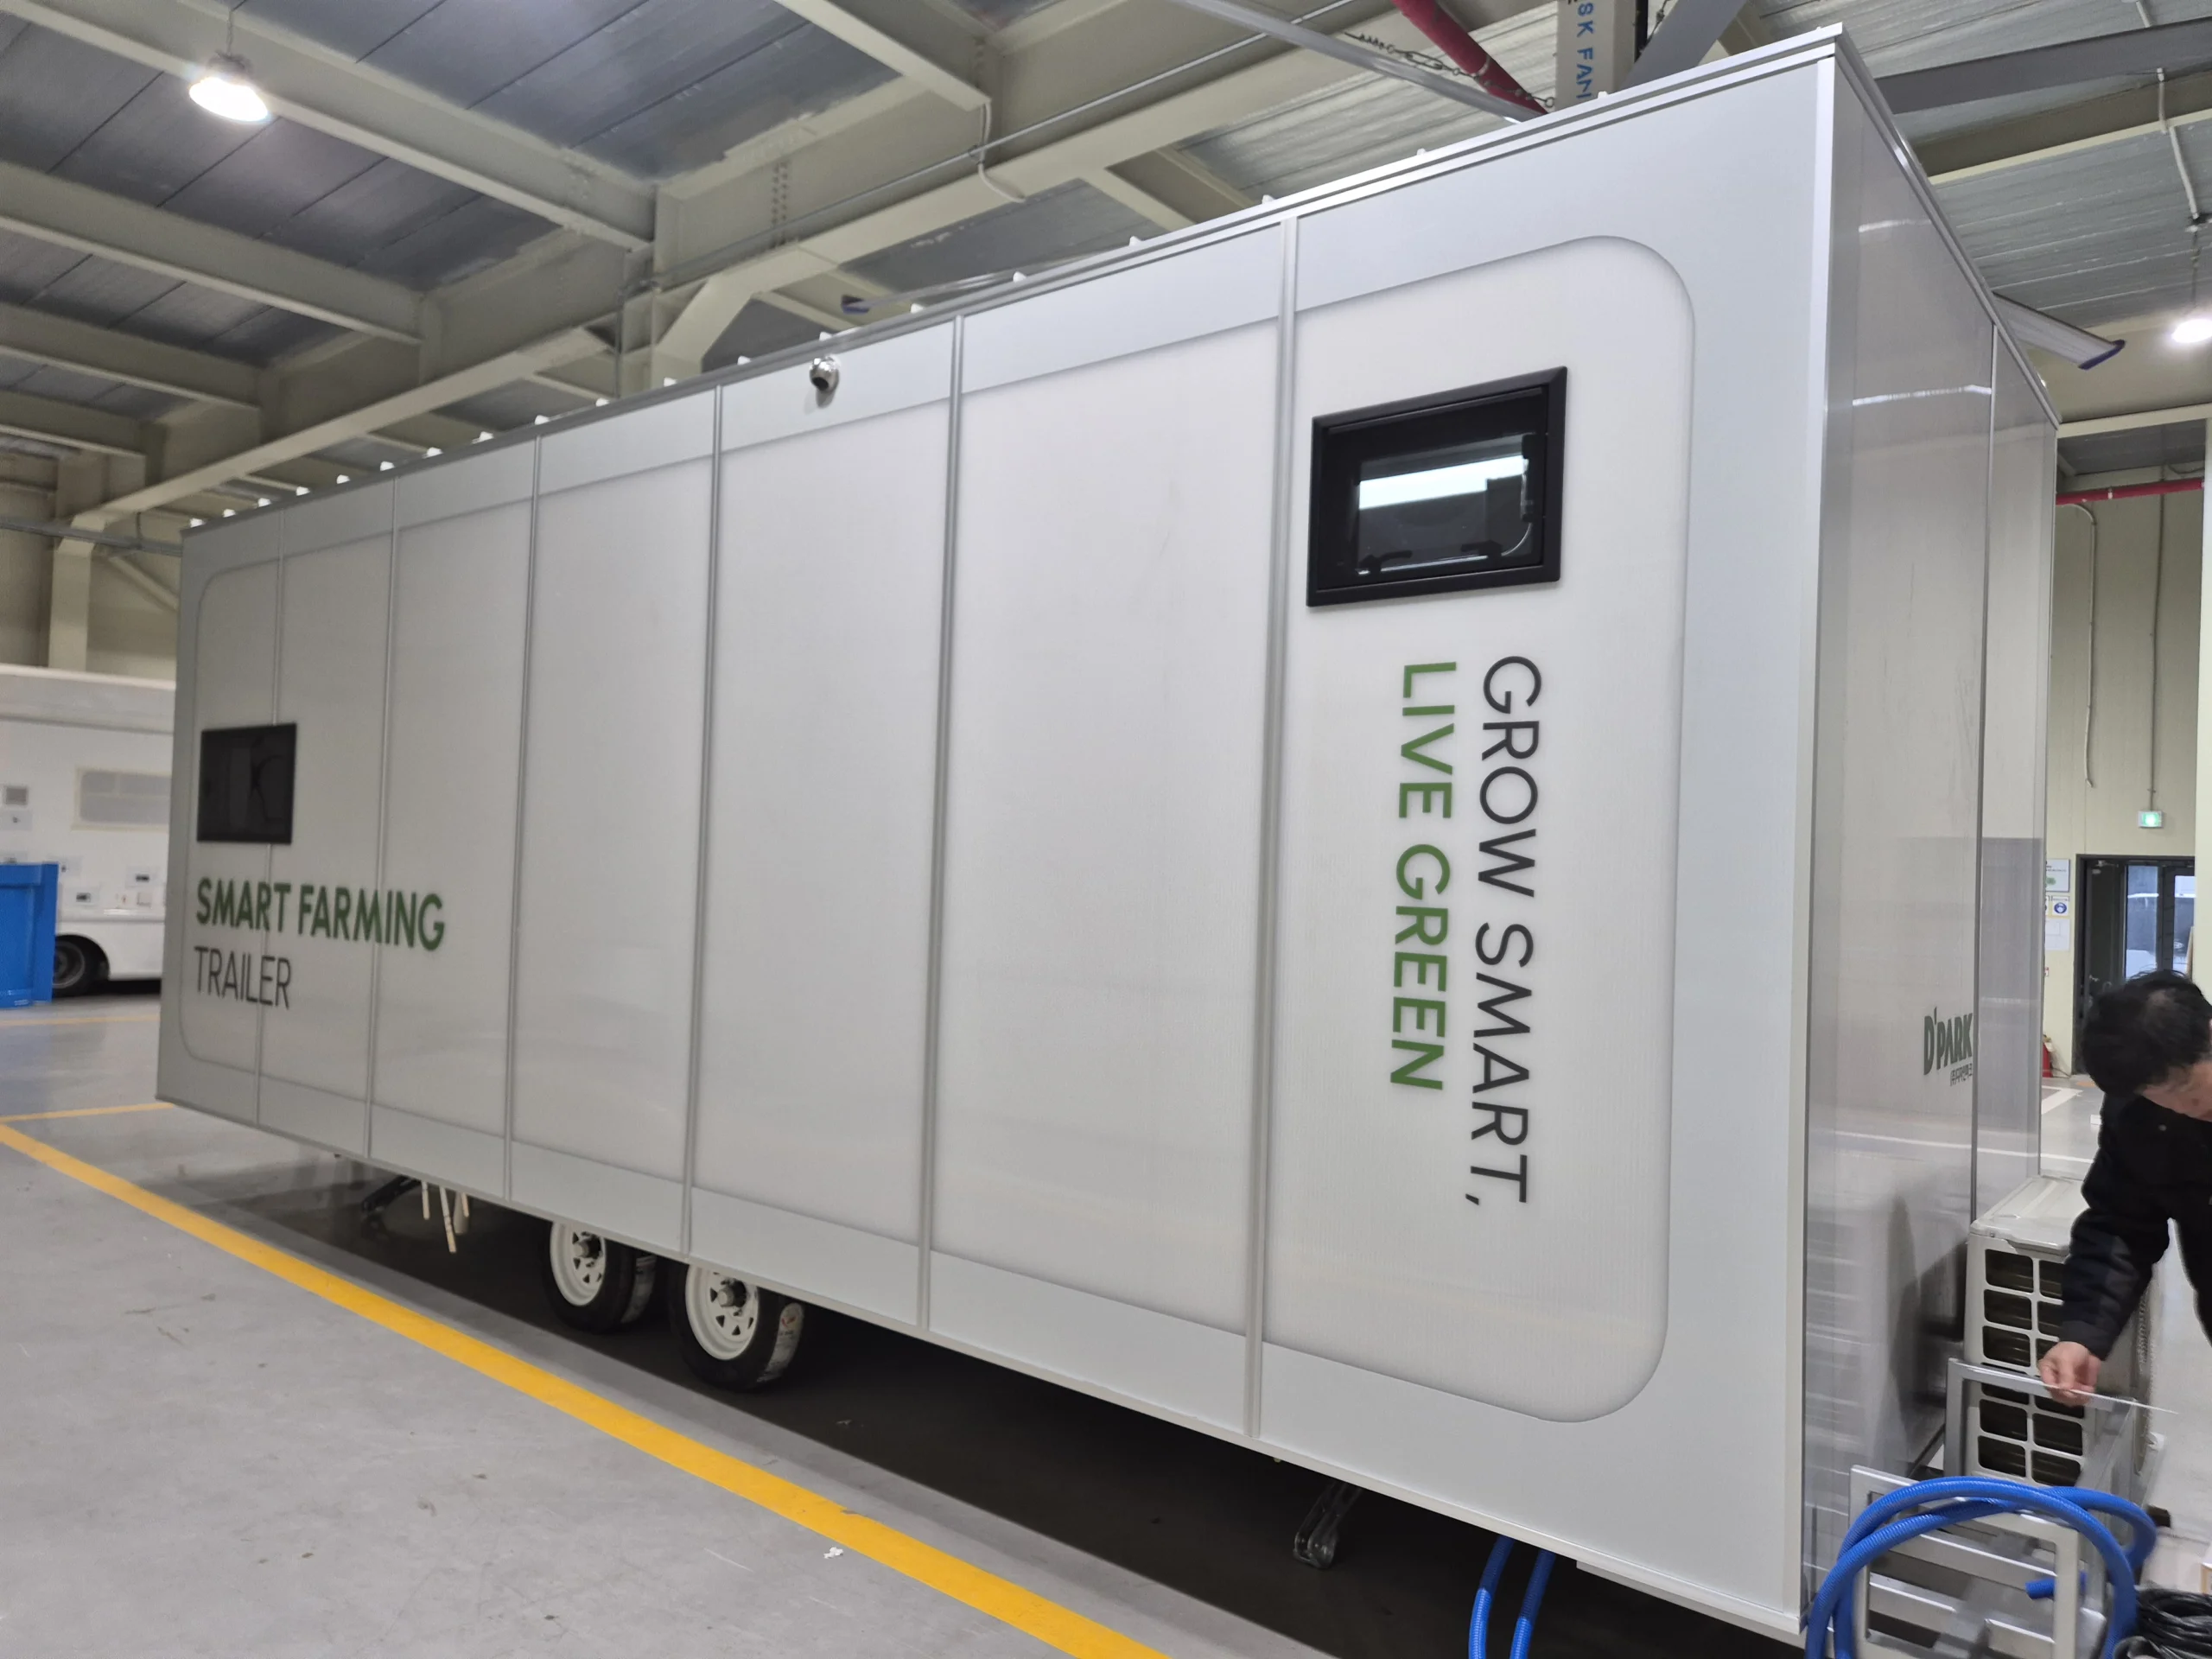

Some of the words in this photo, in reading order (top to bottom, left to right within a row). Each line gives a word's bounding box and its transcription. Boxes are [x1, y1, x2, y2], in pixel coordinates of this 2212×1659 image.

[1577, 3, 1594, 37] SK
[1398, 662, 1458, 820] LIVE
[1478, 656, 1544, 899] GROW
[195, 877, 292, 933] SMART
[297, 883, 446, 952] FARMING
[1390, 844, 1452, 1091] GREEN
[194, 945, 292, 1010] TRAILER
[1465, 922, 1536, 1205] SMART,
[1923, 1006, 1974, 1076] D'PARK
